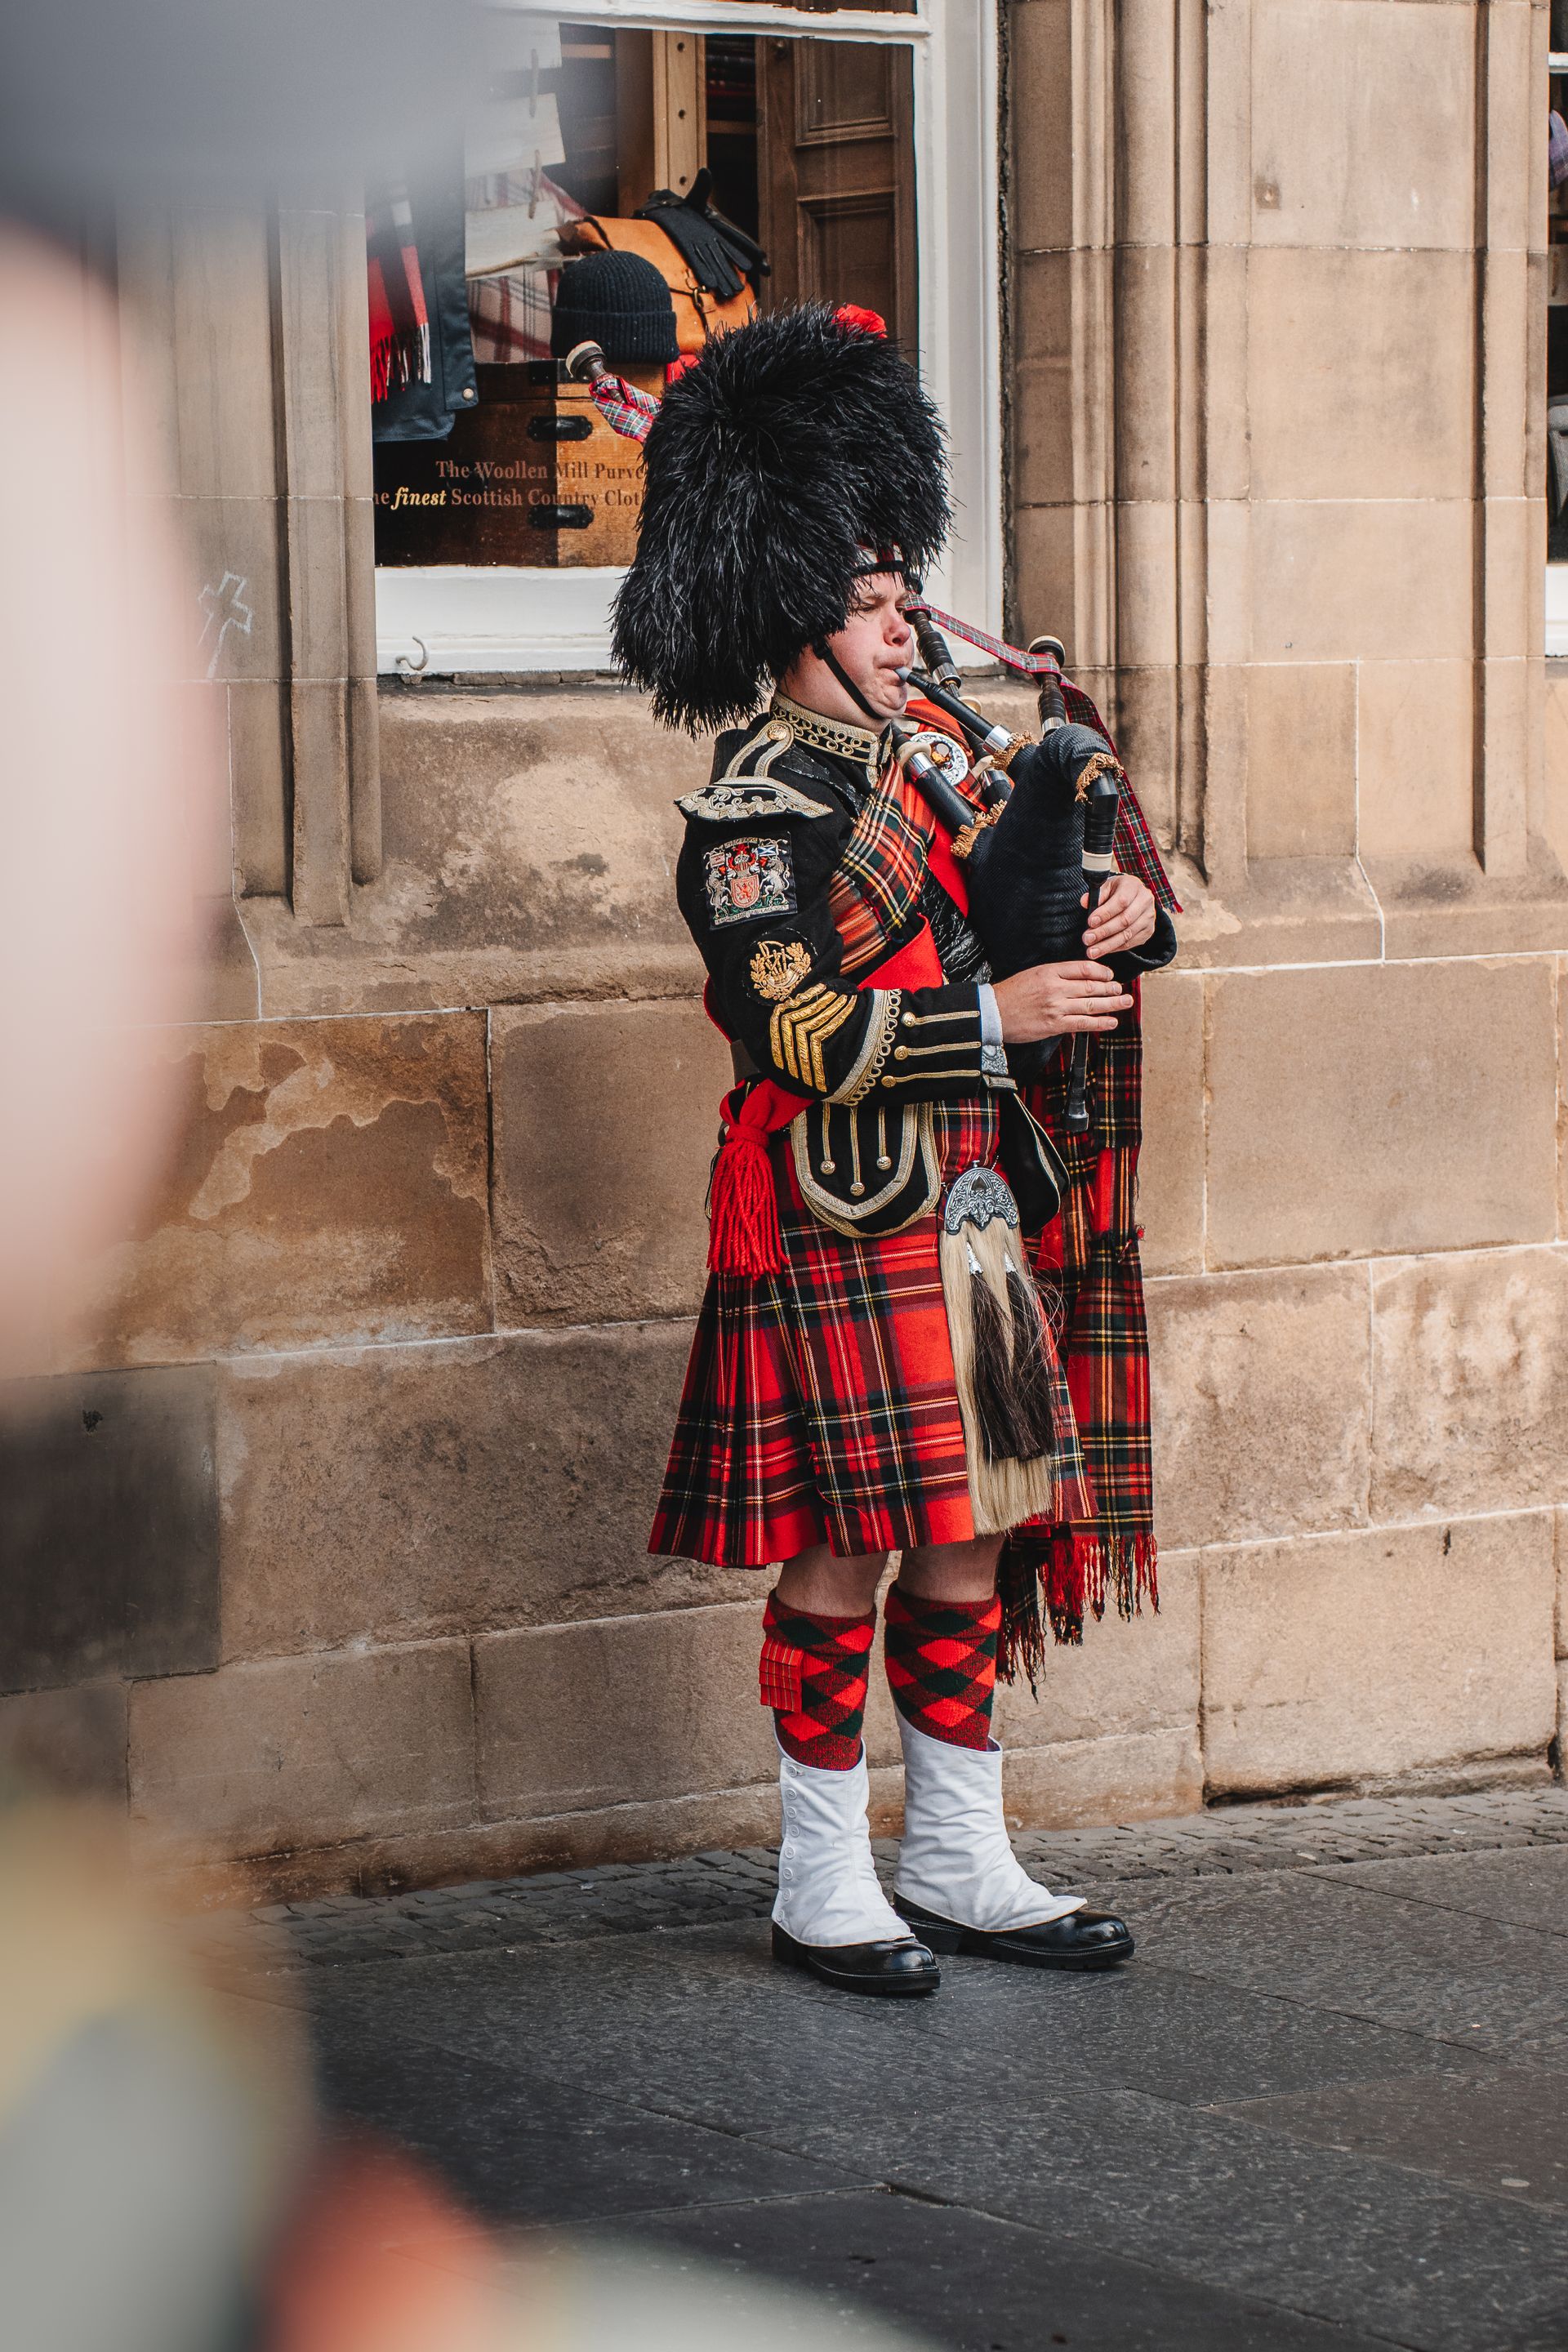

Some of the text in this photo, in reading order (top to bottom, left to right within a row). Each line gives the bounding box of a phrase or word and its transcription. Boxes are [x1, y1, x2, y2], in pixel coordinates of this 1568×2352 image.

[435, 460, 470, 479] The
[474, 460, 548, 479] Woollen
[555, 461, 588, 479] Mill
[390, 487, 447, 510] finest
[452, 488, 522, 506] Scottish
[528, 488, 599, 510] Country
